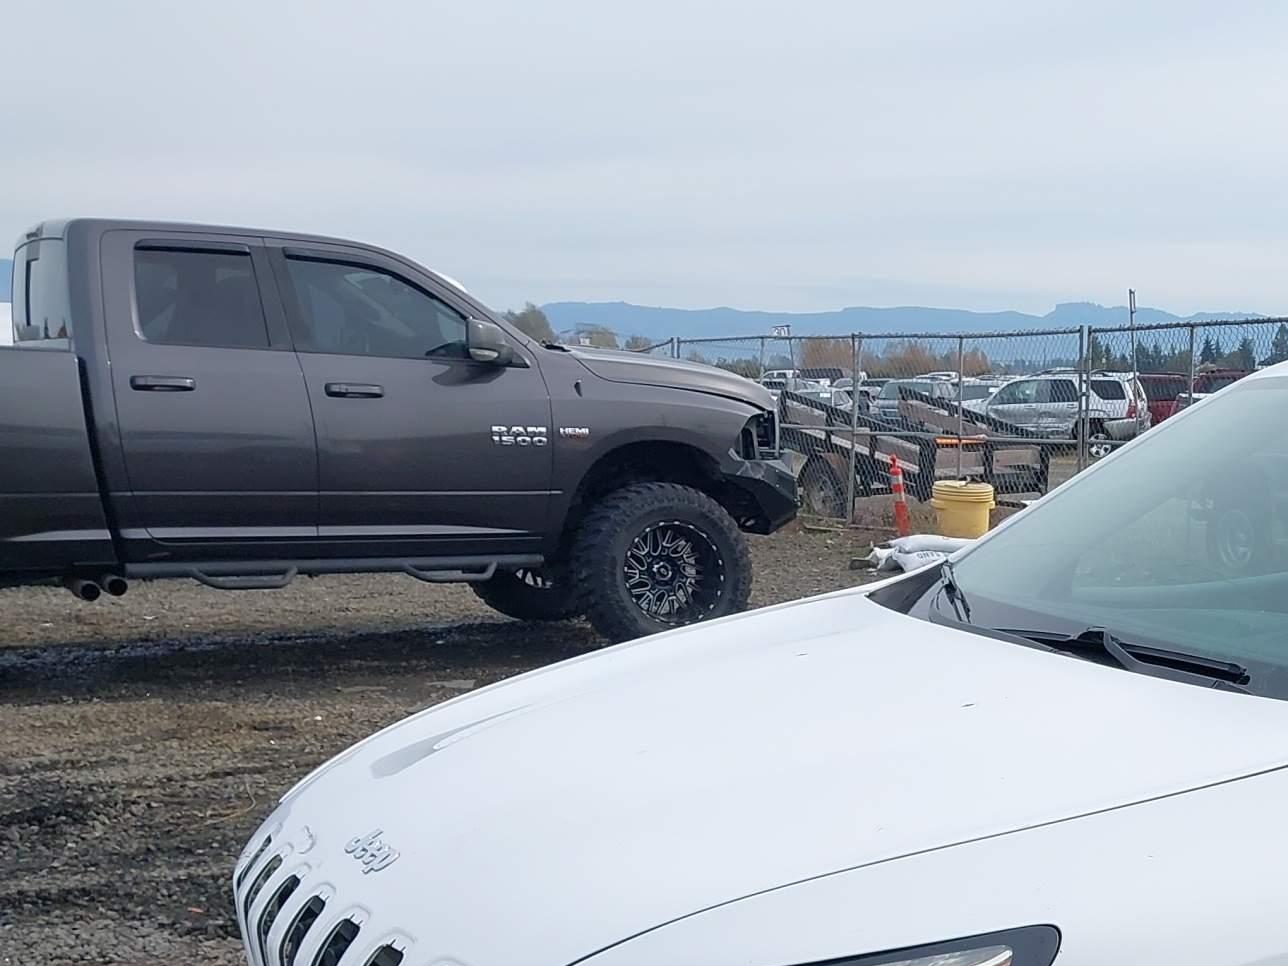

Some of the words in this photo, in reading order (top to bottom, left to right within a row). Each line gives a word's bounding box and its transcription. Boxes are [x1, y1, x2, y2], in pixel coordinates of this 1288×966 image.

[491, 425, 547, 436] RAM
[559, 427, 589, 435] HEMI
[492, 436, 548, 446] 1500
